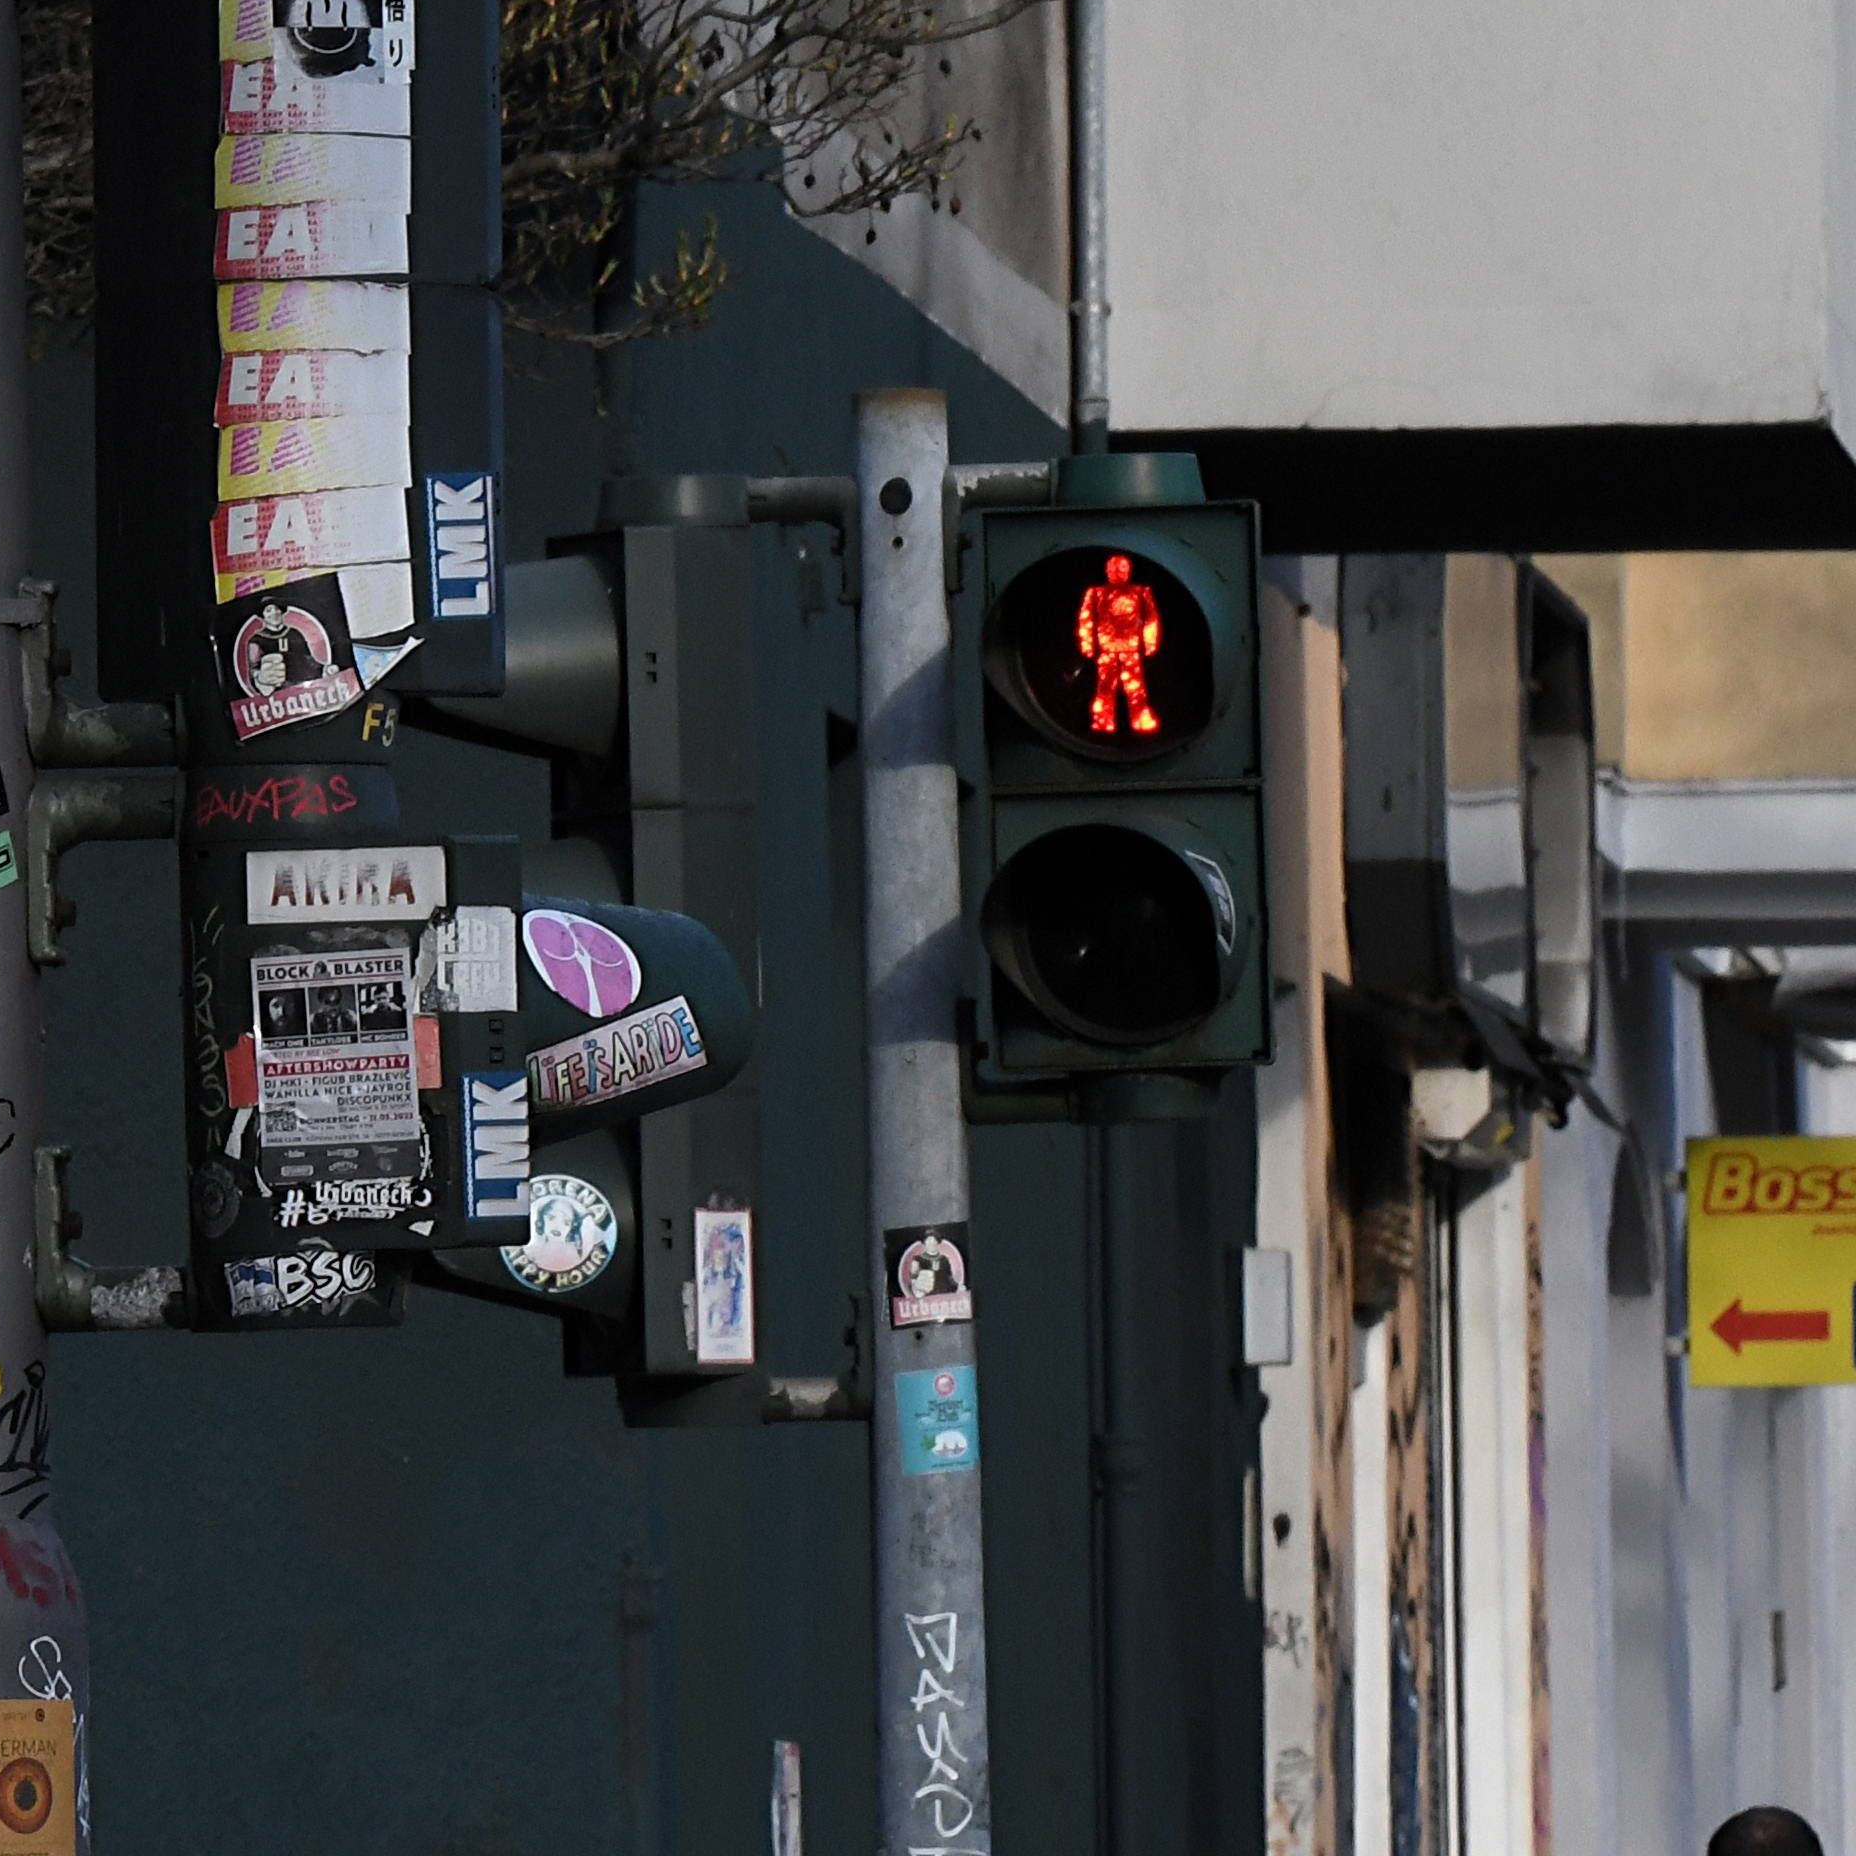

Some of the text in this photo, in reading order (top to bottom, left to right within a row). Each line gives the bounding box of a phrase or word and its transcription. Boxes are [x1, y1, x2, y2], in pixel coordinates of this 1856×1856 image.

[433, 475, 490, 618] LMK
[270, 859, 417, 907] AKIRA
[257, 959, 404, 981] BLOCK BLASTER
[266, 1055, 407, 1076] AFTERSHOWPARTY
[265, 1088, 319, 1099] WANILLA
[324, 1085, 353, 1096] NICE
[337, 1093, 412, 1106] DISCOPUNKX
[473, 1075, 531, 1219] LMK
